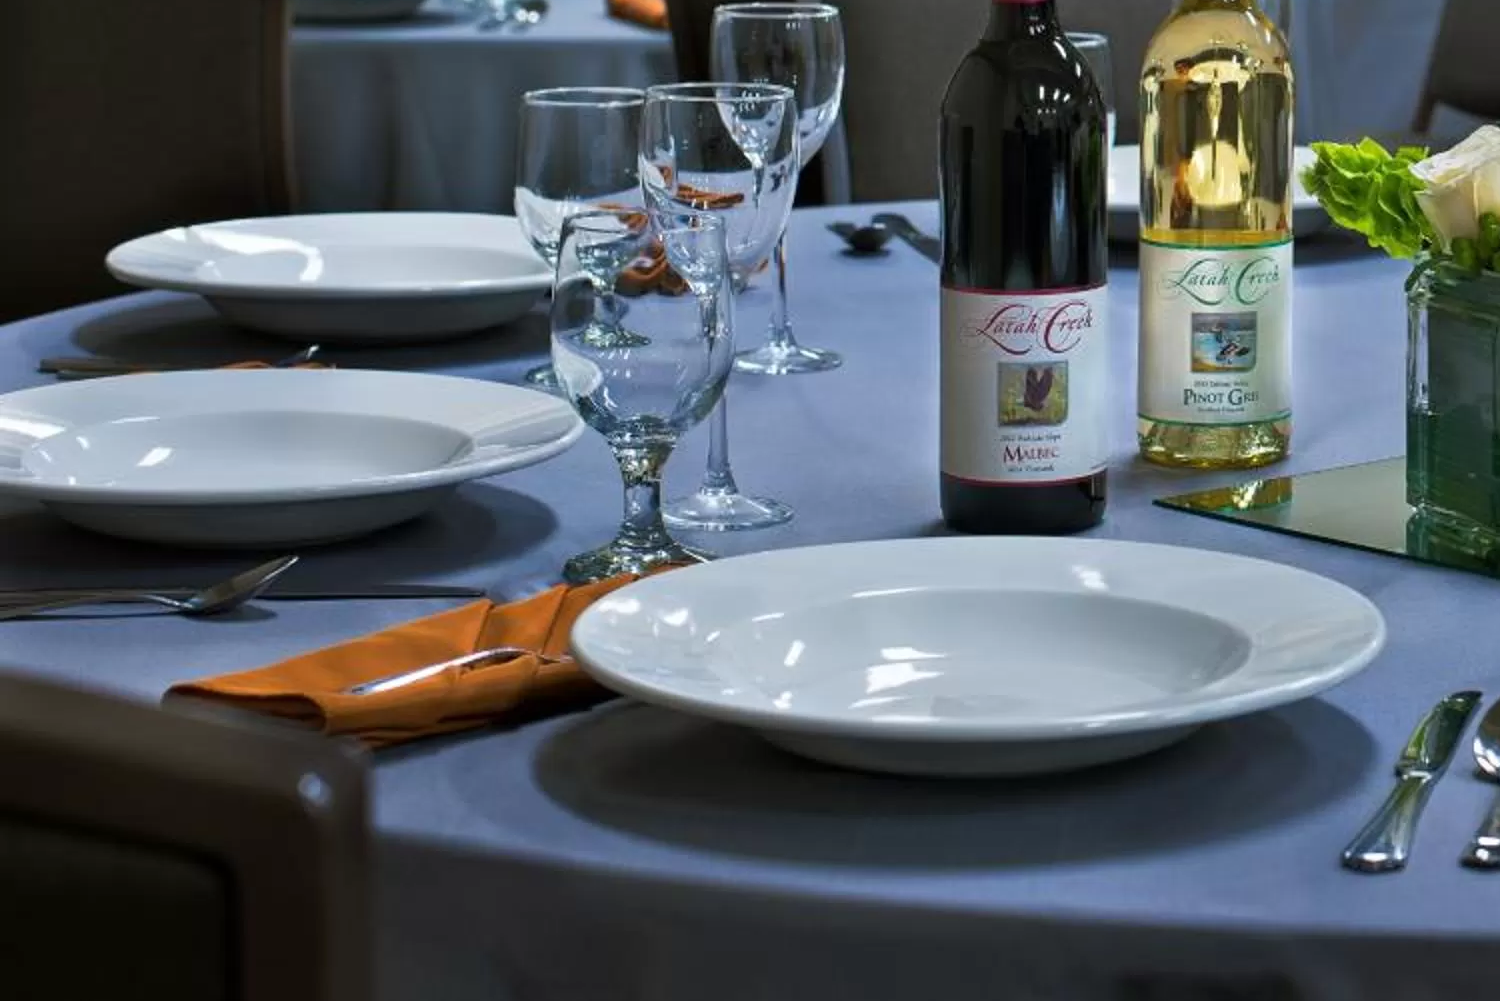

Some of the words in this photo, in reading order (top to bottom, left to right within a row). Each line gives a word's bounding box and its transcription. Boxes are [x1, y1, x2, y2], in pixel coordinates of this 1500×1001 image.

[1160, 257, 1231, 306] Latah
[1233, 256, 1280, 305] Creek
[966, 303, 1038, 356] Latah
[1037, 301, 1093, 354] Creek
[1183, 388, 1224, 406] PINOT
[1003, 445, 1061, 464] MALBEC
